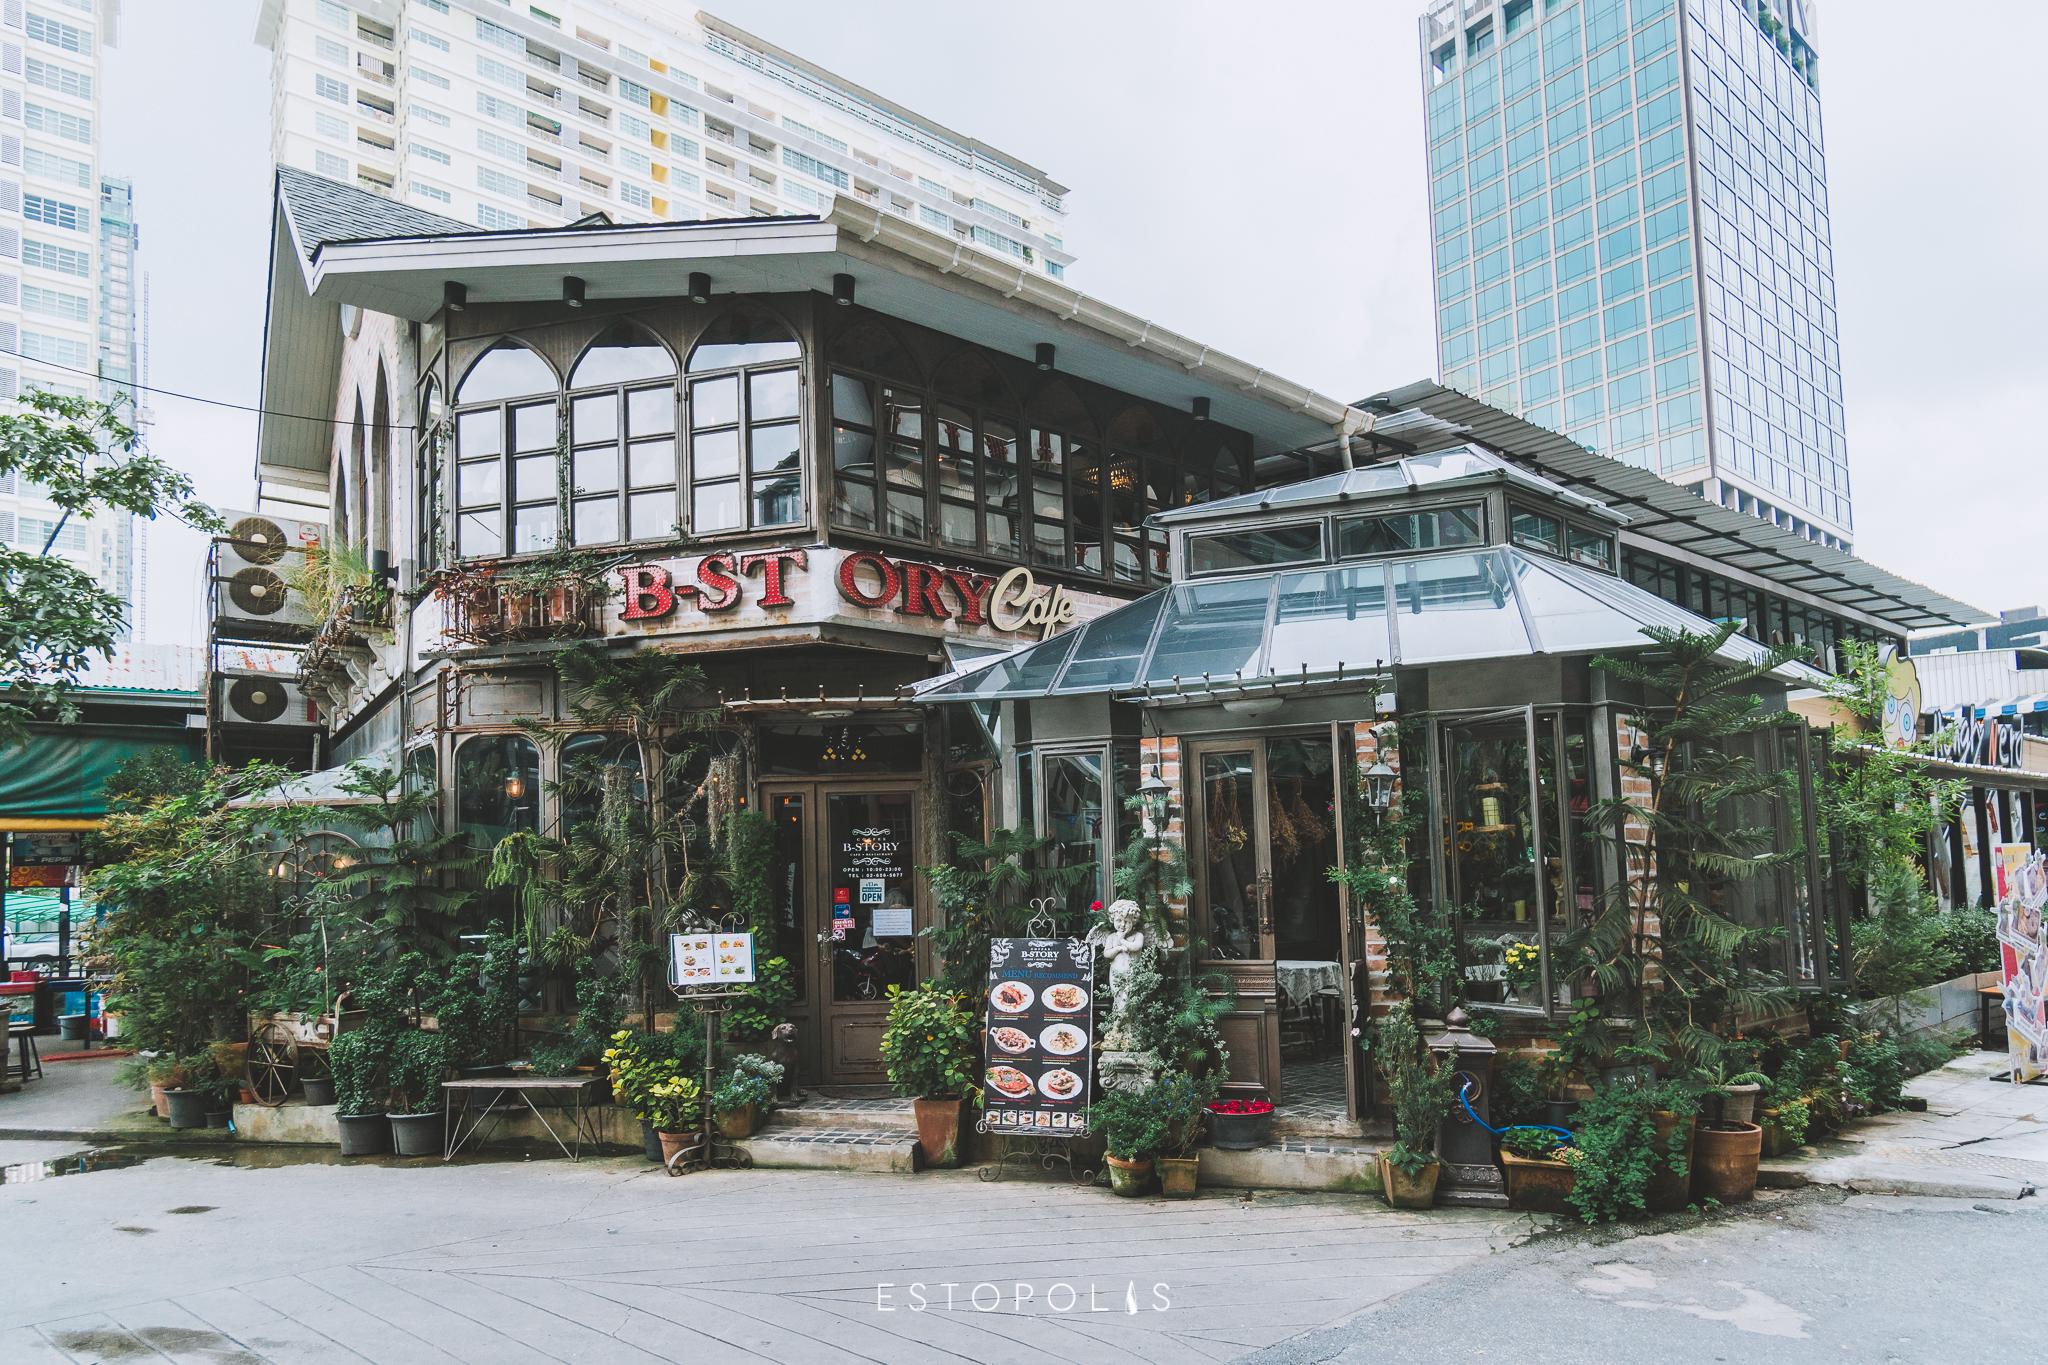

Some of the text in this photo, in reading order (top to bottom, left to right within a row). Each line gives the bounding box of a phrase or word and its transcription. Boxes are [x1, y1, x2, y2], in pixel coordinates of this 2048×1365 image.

[989, 567, 1075, 640] Cafe
[843, 842, 899, 851] B-STORY
[862, 893, 882, 902] OPEN
[1002, 969, 1032, 977] MENU
